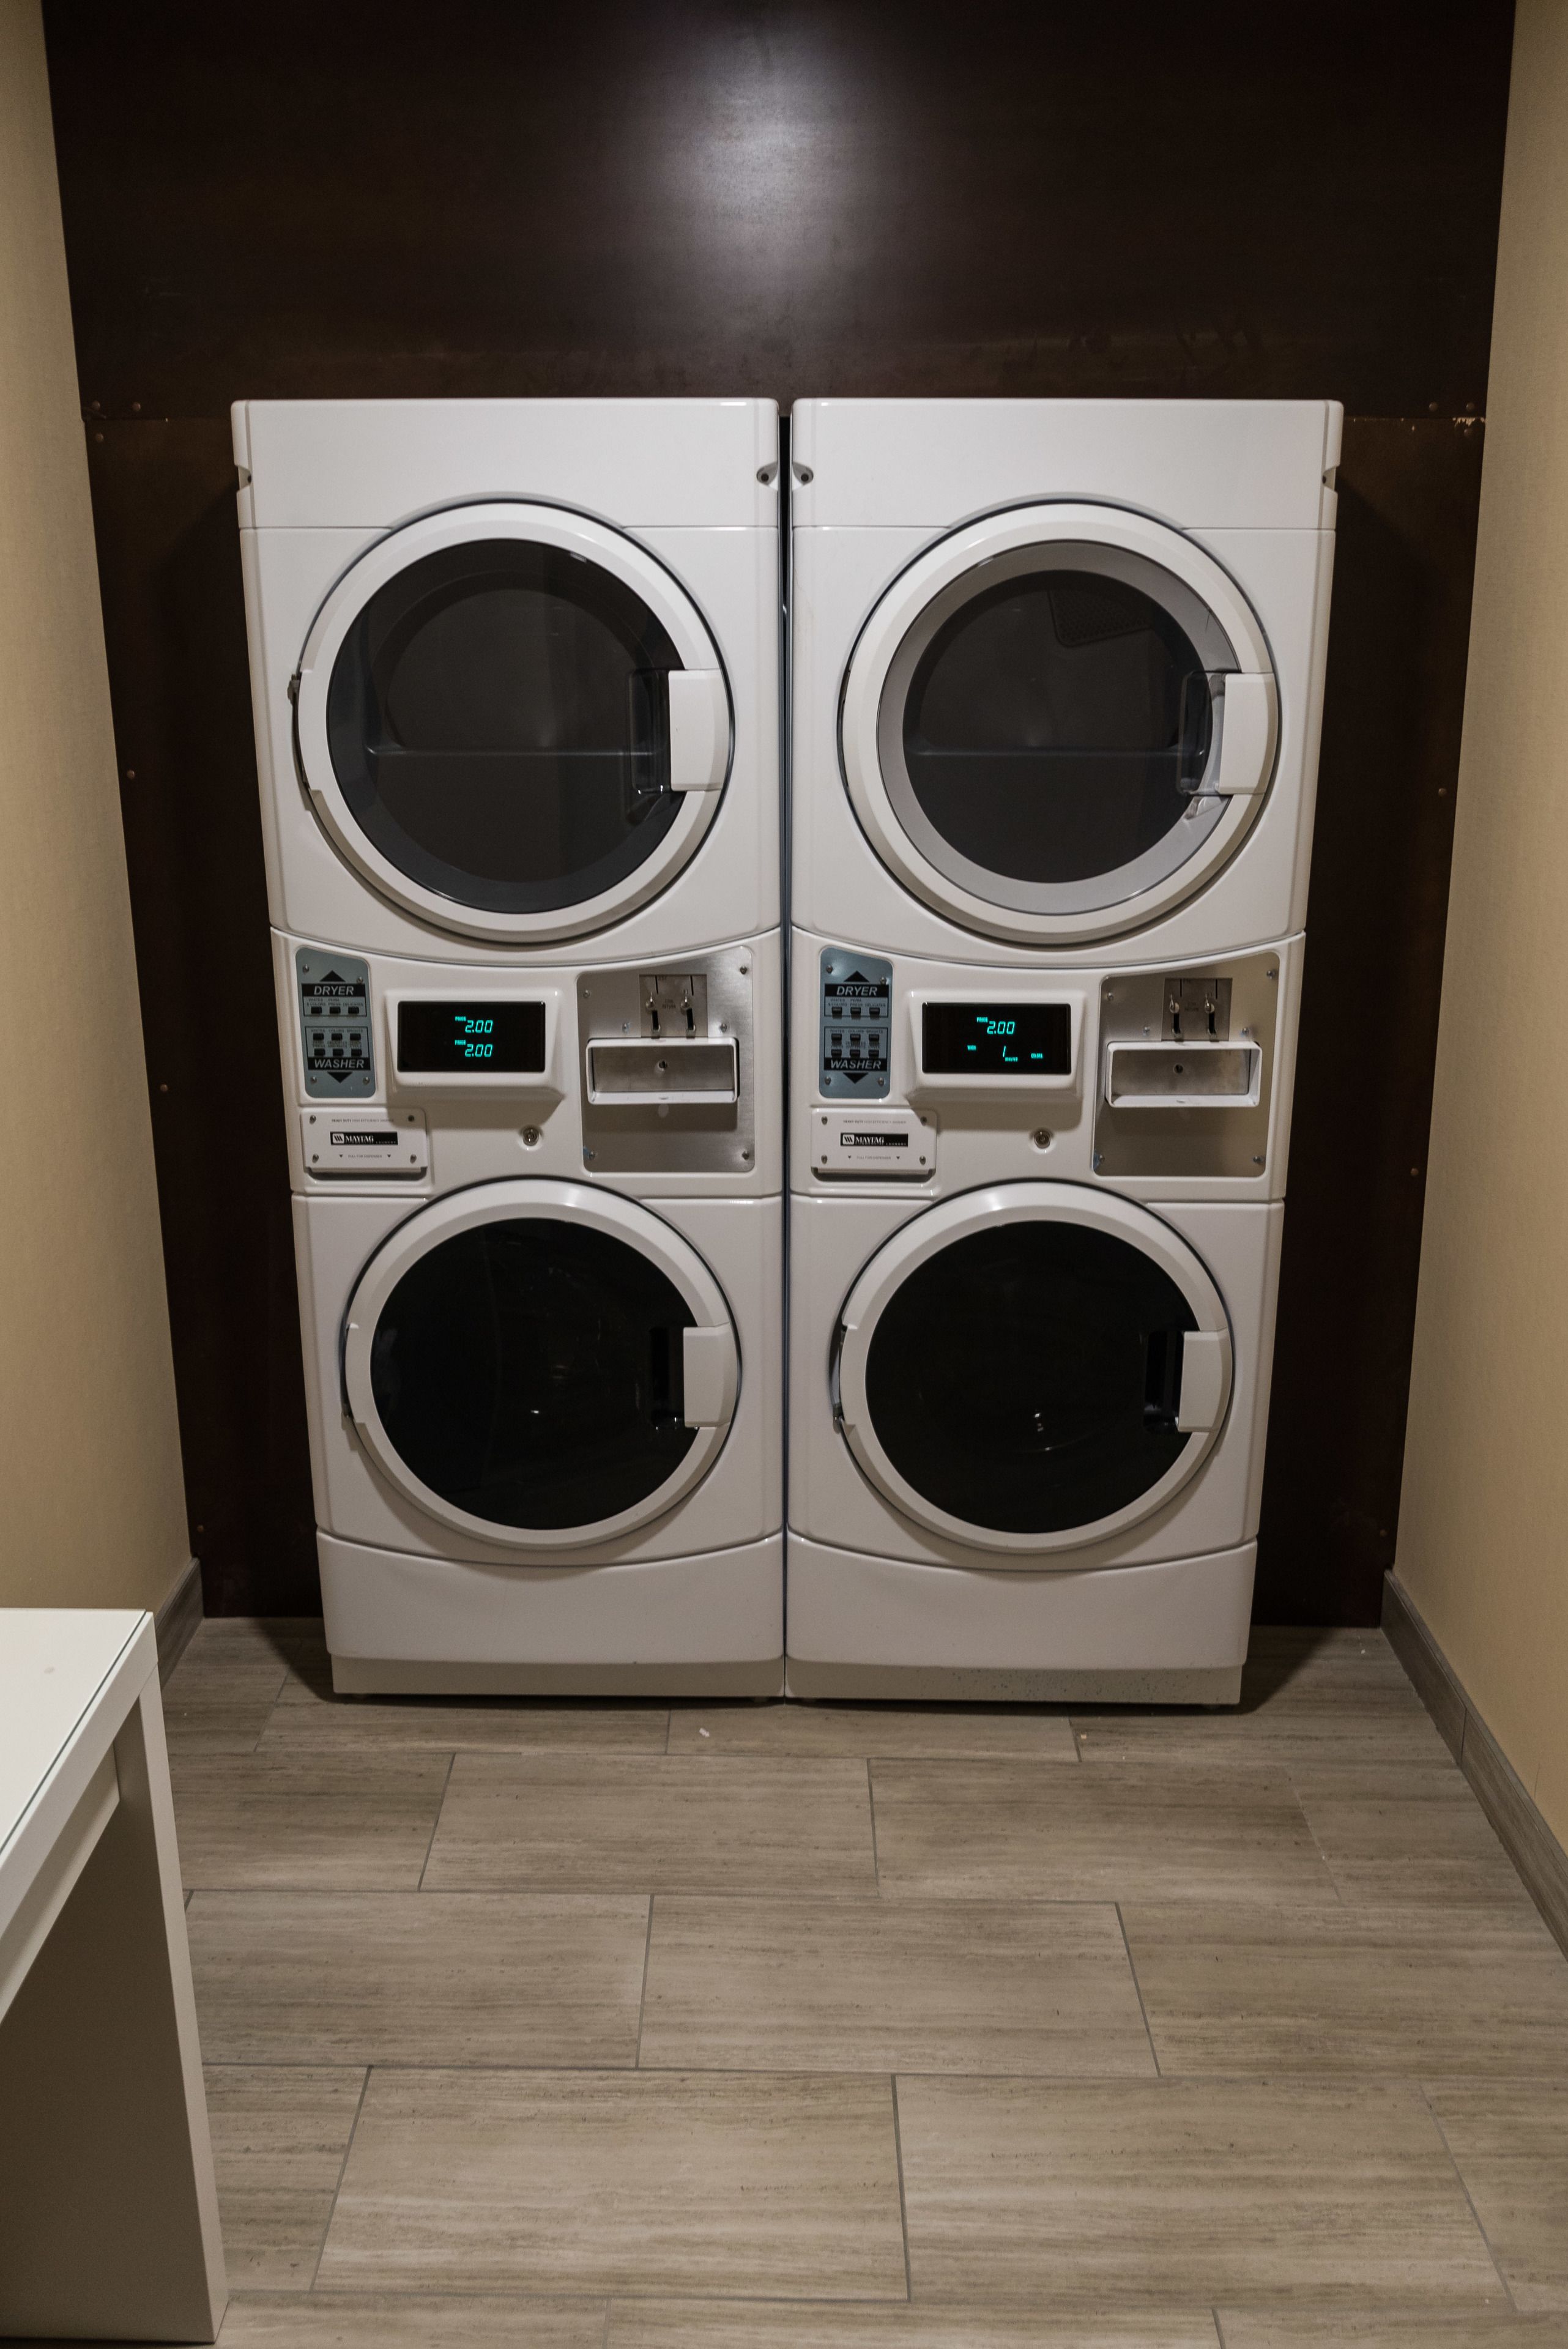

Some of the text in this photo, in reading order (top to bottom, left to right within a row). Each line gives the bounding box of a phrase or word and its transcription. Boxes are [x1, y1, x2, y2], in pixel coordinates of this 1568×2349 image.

[314, 985, 354, 996] DRYER
[836, 985, 877, 996] DRYER
[465, 1020, 493, 1033] 2.00
[987, 1021, 1015, 1034] 2.00
[465, 1044, 493, 1057] 2.00
[314, 1059, 365, 1069] WASHER
[831, 1059, 882, 1069] WASHER
